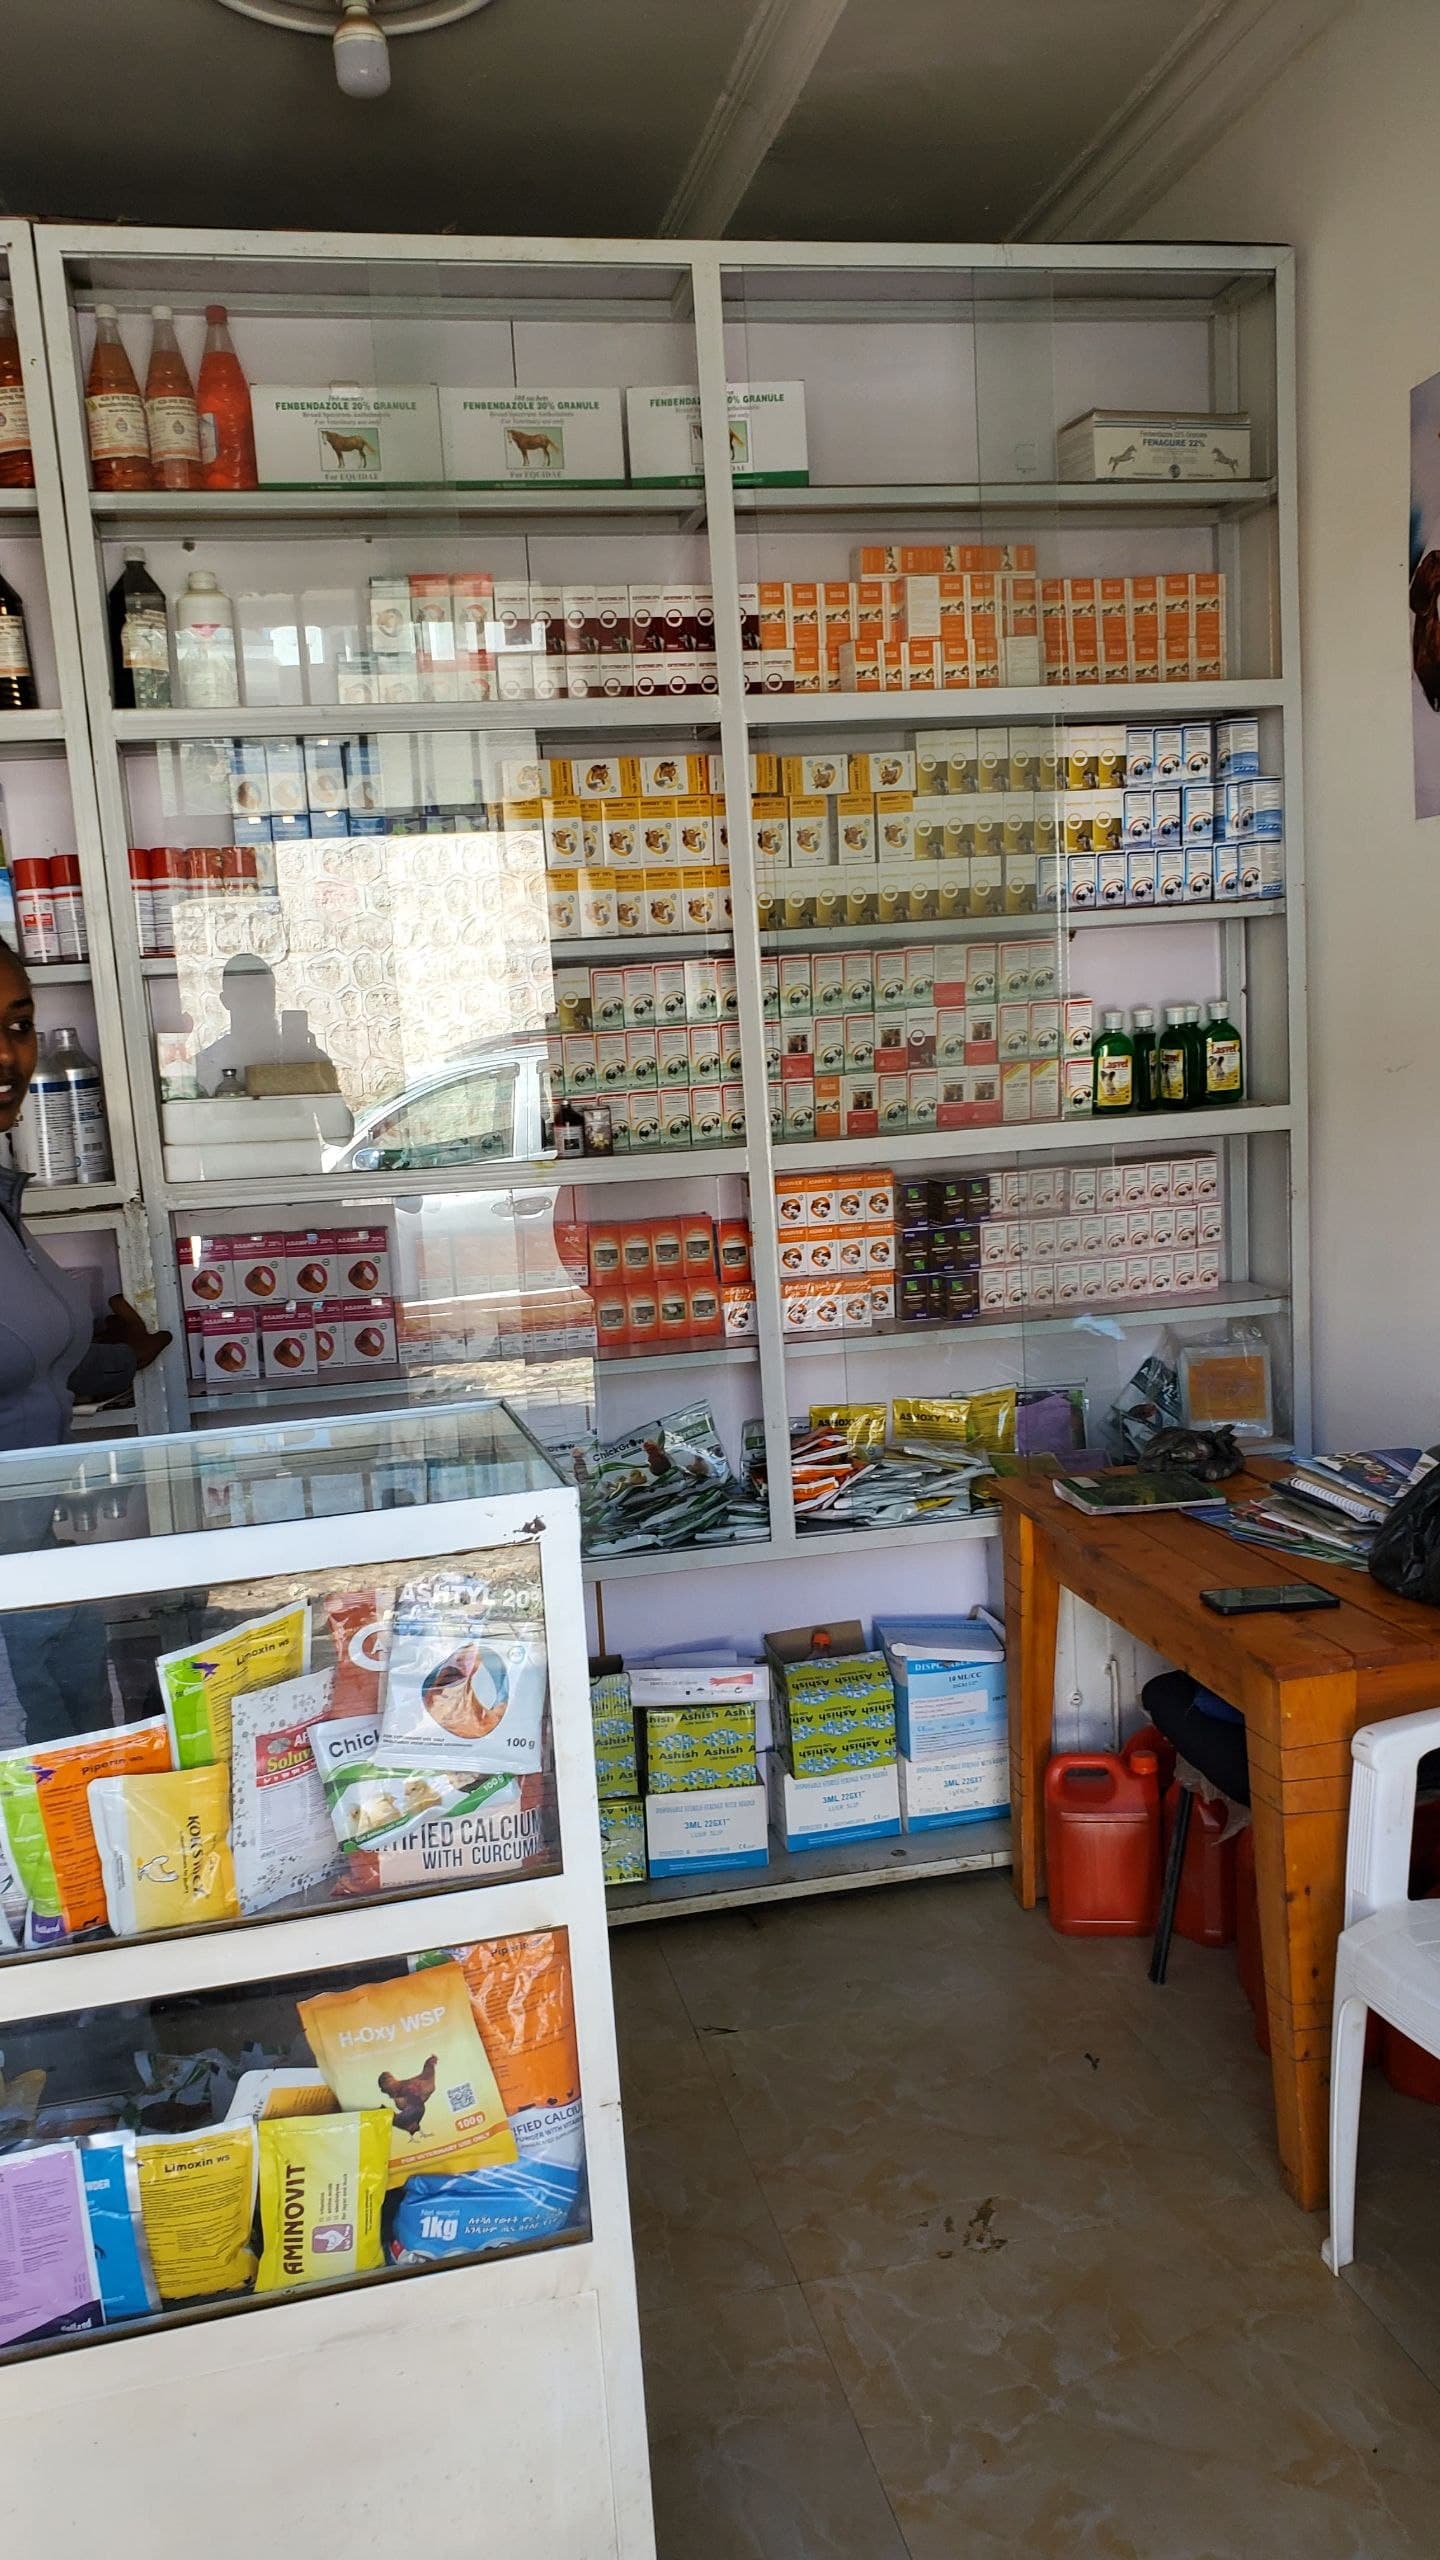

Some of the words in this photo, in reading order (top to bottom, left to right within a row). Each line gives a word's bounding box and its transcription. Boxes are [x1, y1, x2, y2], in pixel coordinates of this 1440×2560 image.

[275, 401, 349, 411] FENBENDAZOLE
[352, 401, 371, 411] 20%
[373, 401, 417, 411] GRANULE
[463, 401, 534, 411] FENBENDAZOLE
[537, 401, 555, 411] 20%
[558, 401, 600, 410] GRANULE
[650, 397, 700, 408] FENBENDA
[743, 393, 785, 404] GRANULE
[236, 1644, 276, 1667] Limoxin
[792, 1679, 830, 1691] Ashish
[834, 1672, 873, 1684] Ashish
[680, 1711, 719, 1722] Ashish
[724, 1708, 756, 1718] Ashis
[818, 1708, 857, 1720] Ashish
[506, 1737, 527, 1747] 100
[842, 1739, 880, 1751] Ashish
[659, 1749, 699, 1761] Ashish
[704, 1745, 744, 1757] Ashish
[799, 1746, 837, 1758] Ashish
[81, 1757, 126, 1776] Piperin
[266, 1747, 314, 1773] Soluv
[684, 1819, 702, 1830] 3ML
[422, 1850, 463, 1870] WITH
[337, 2023, 397, 2049] H-Oxy
[399, 2005, 446, 2033] WSP
[164, 2158, 214, 2174] Limoxin
[283, 2163, 306, 2275] AMINOVIT
[419, 2215, 459, 2241] 1kg
